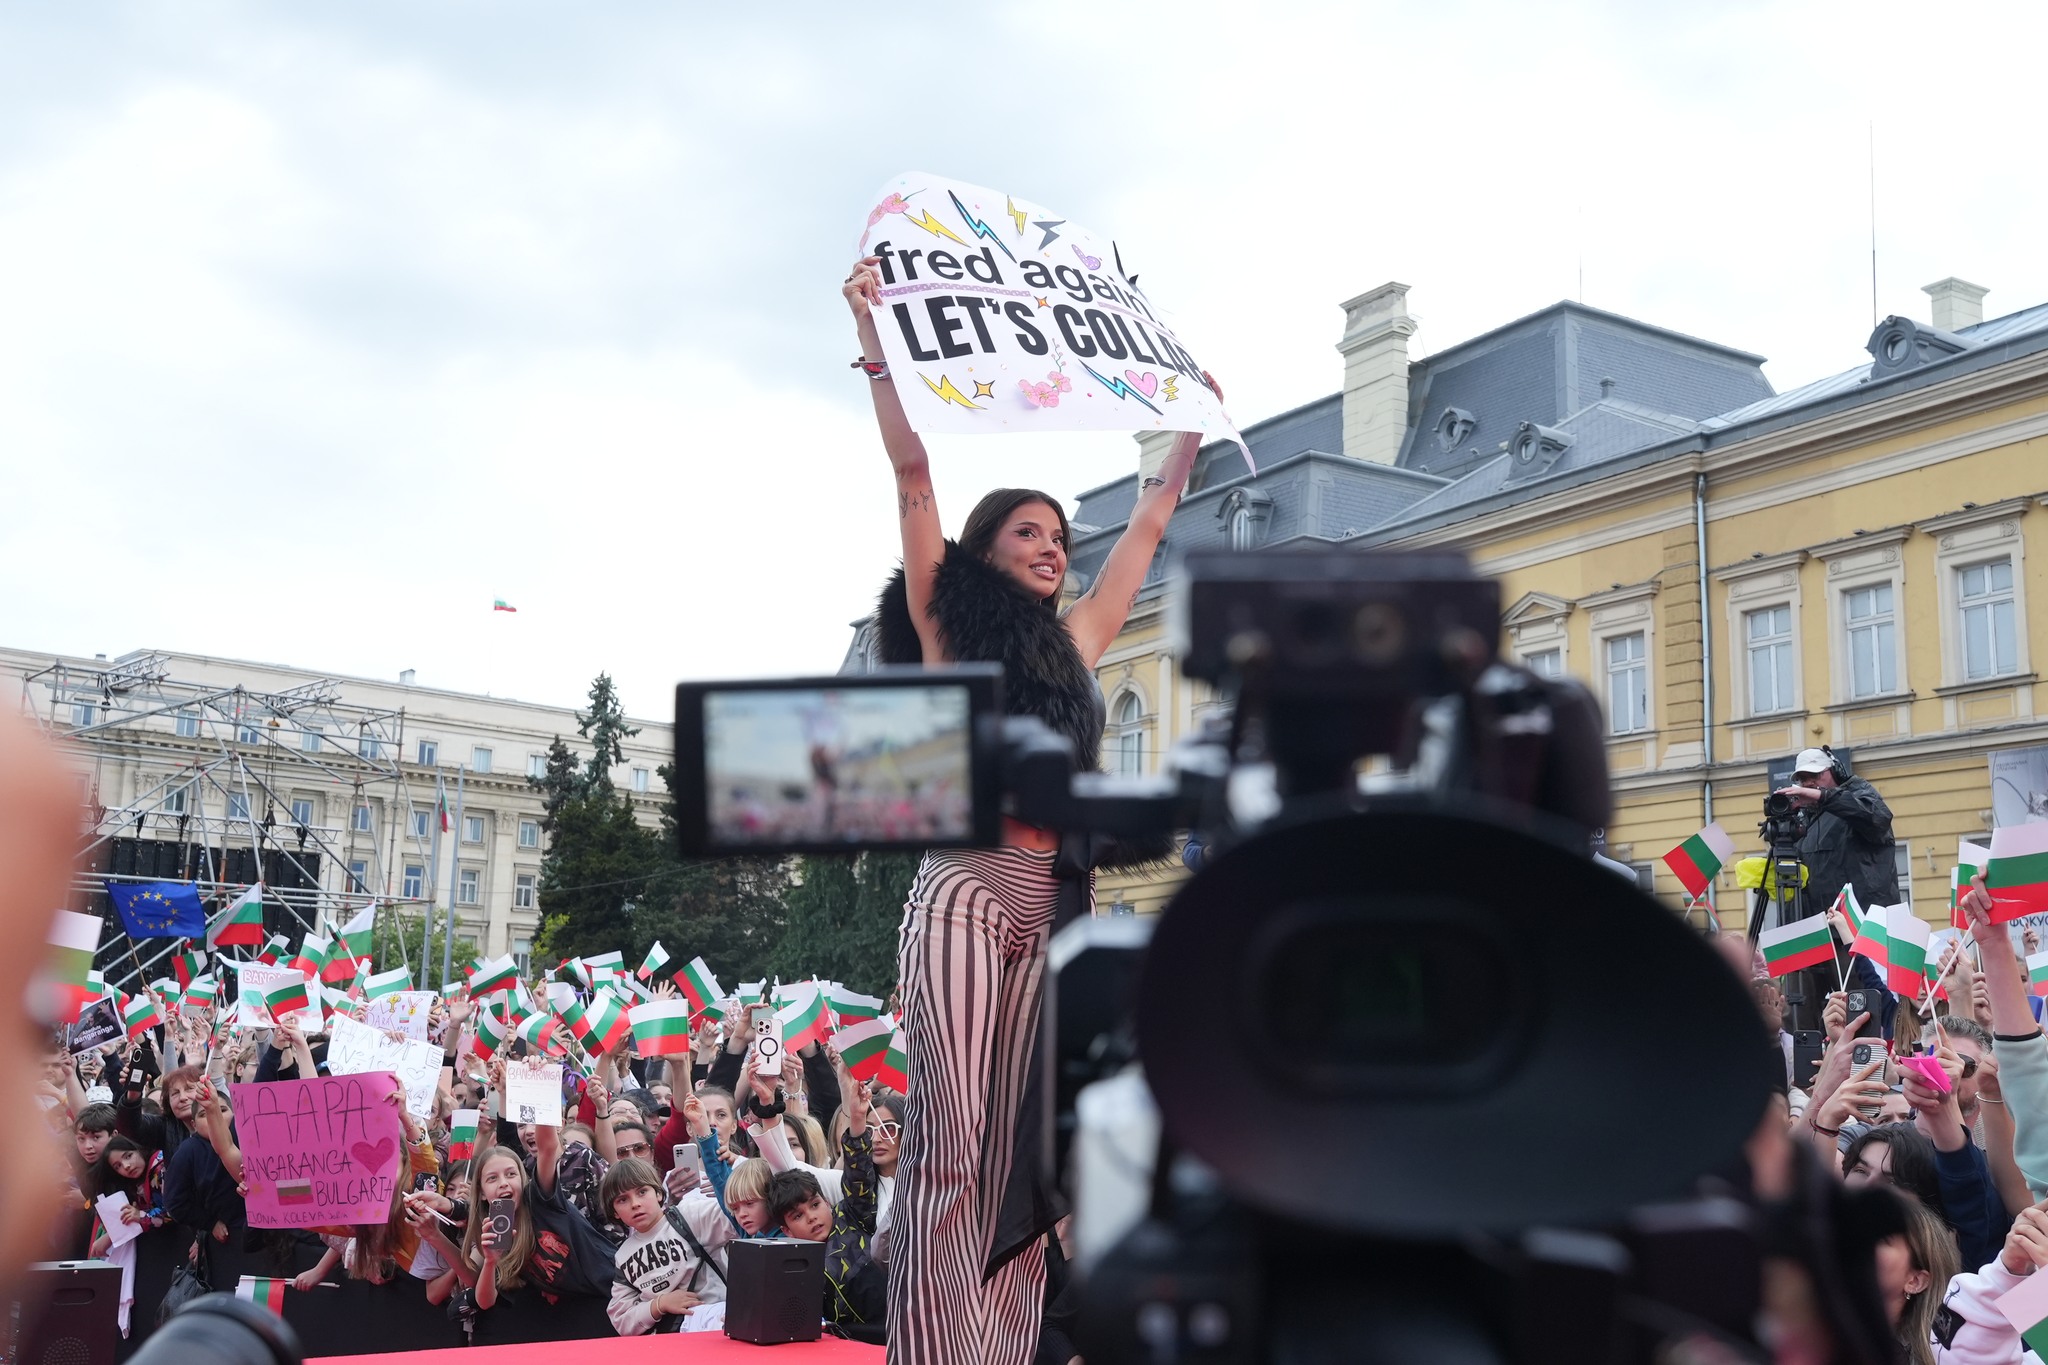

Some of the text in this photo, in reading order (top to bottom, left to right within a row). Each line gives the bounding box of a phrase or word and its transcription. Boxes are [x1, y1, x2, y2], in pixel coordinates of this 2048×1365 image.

[873, 240, 1005, 285] fred
[893, 295, 1214, 392] LET'S COLLAB
[74, 1025, 114, 1045] Bangaranga
[253, 1079, 372, 1148] ДАРА
[315, 1176, 393, 1207] BULGARIA
